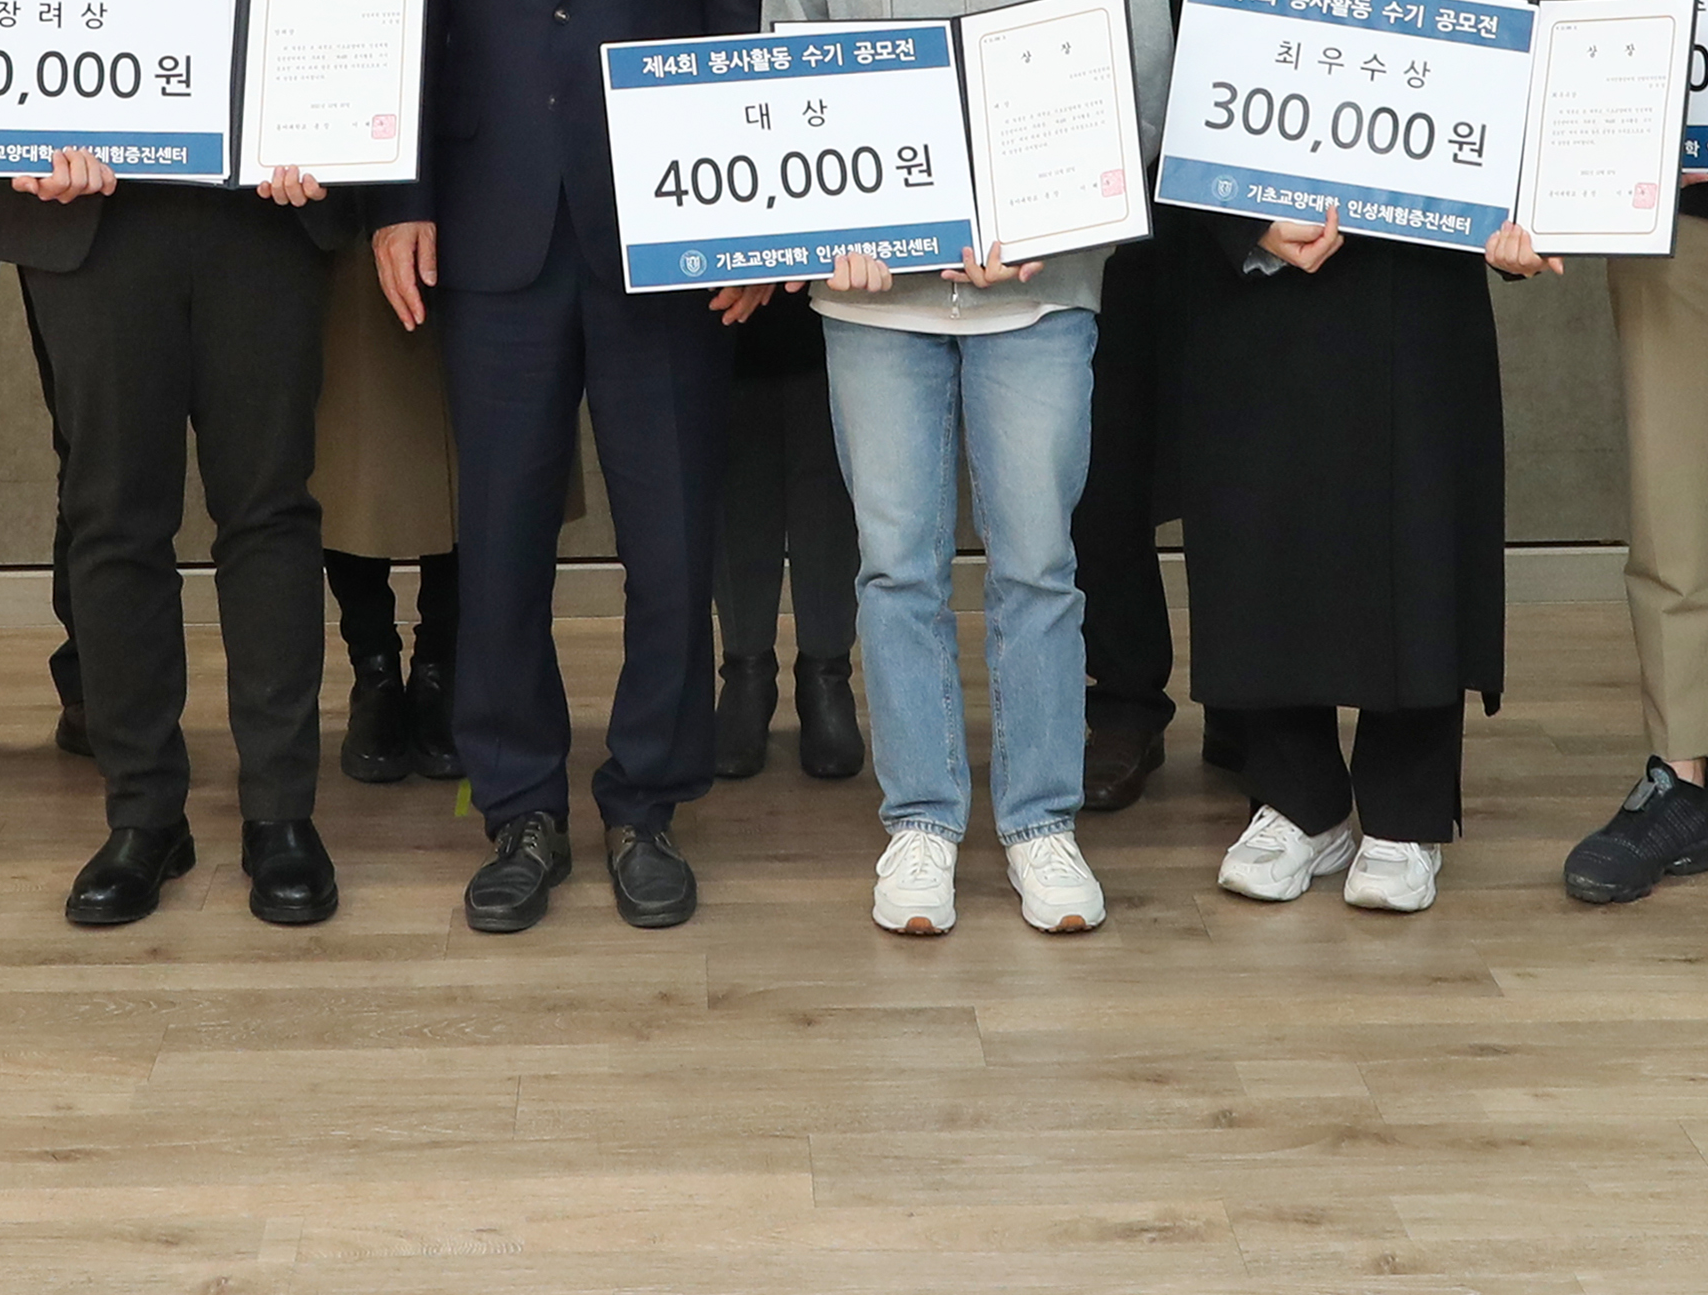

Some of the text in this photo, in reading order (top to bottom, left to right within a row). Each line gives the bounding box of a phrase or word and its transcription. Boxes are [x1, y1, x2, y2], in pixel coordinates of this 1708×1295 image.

[1381, 1, 1425, 28] 수기
[1435, 8, 1498, 39] 공모전
[154, 55, 192, 97] 원
[642, 38, 916, 78] 제4회 봉사활동 수기 공모전
[1204, 76, 1487, 167] 300,000 원
[1685, 141, 1699, 156] 학
[654, 143, 934, 209] 400,000 원
[1347, 200, 1471, 235] 인성체험증진센터
[716, 246, 809, 271] 기초교양대학
